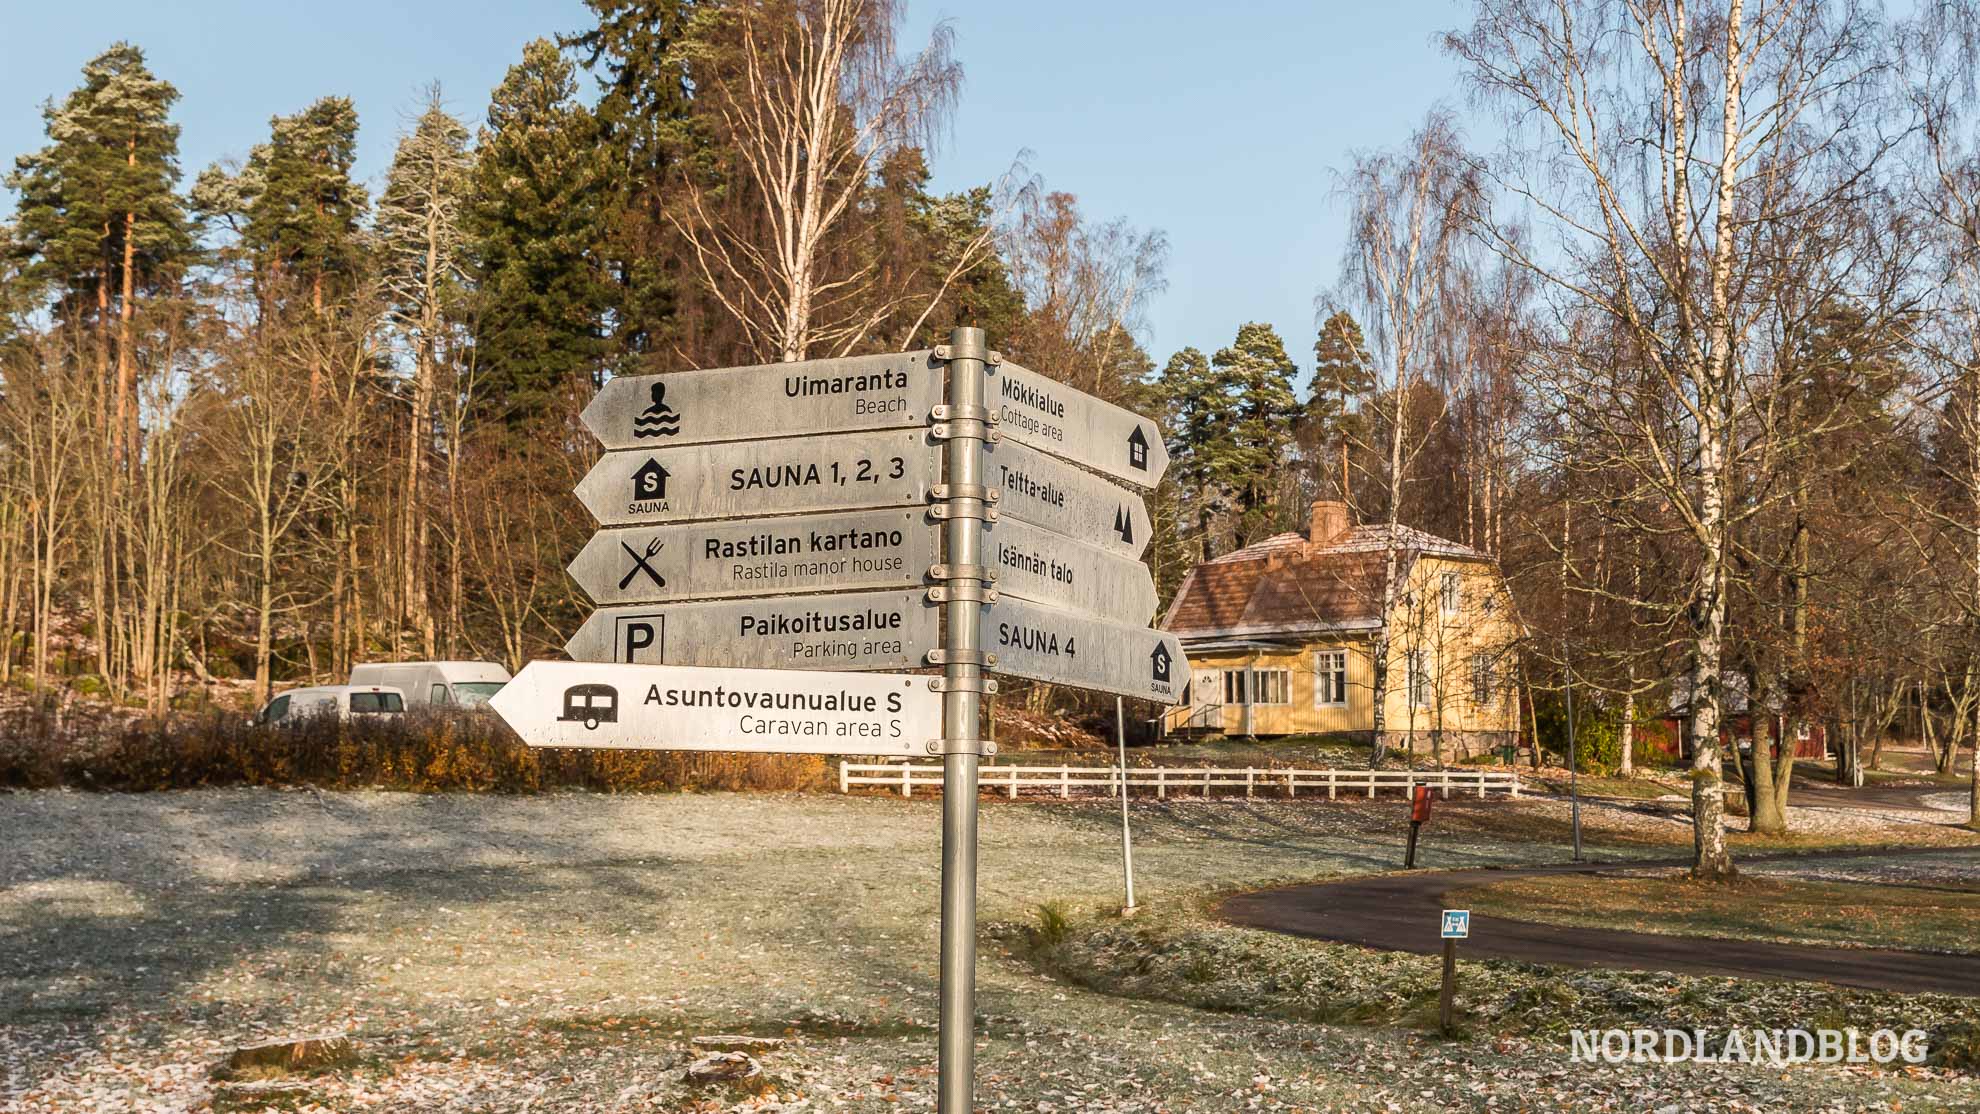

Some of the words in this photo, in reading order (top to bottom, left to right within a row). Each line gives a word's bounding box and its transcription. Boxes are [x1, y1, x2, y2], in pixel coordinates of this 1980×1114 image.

[785, 368, 908, 398] Uimaranta
[1002, 376, 1064, 418] Mökkialue
[855, 397, 907, 415] Beach
[1001, 405, 1039, 435] Cottage
[1041, 422, 1063, 442] area
[643, 471, 658, 494] S
[730, 463, 821, 491] SAUNA
[831, 461, 846, 486] 1,
[856, 459, 880, 484] 2,
[888, 456, 905, 479] 3
[1000, 465, 1064, 508] Teltta-alue
[628, 502, 670, 514] SAUNA
[705, 534, 801, 559] Rastilan
[810, 528, 903, 552] kartano
[733, 562, 788, 580] Rastila
[794, 560, 847, 577] manor
[853, 557, 903, 572] house
[999, 542, 1047, 577] Isännän
[1050, 558, 1073, 585] talo
[740, 608, 901, 637] Paikoitusalue
[626, 622, 655, 663] P
[794, 640, 858, 659] Parking
[864, 640, 901, 655] area
[999, 622, 1059, 656] SAUNA
[1065, 637, 1076, 659] 4
[1157, 654, 1166, 674] S
[643, 684, 877, 713] Asuntovaunualue
[887, 692, 902, 714] S
[1151, 682, 1172, 696] SAUNA
[739, 715, 828, 737] Caravan
[836, 719, 881, 738] area
[889, 718, 902, 738] S
